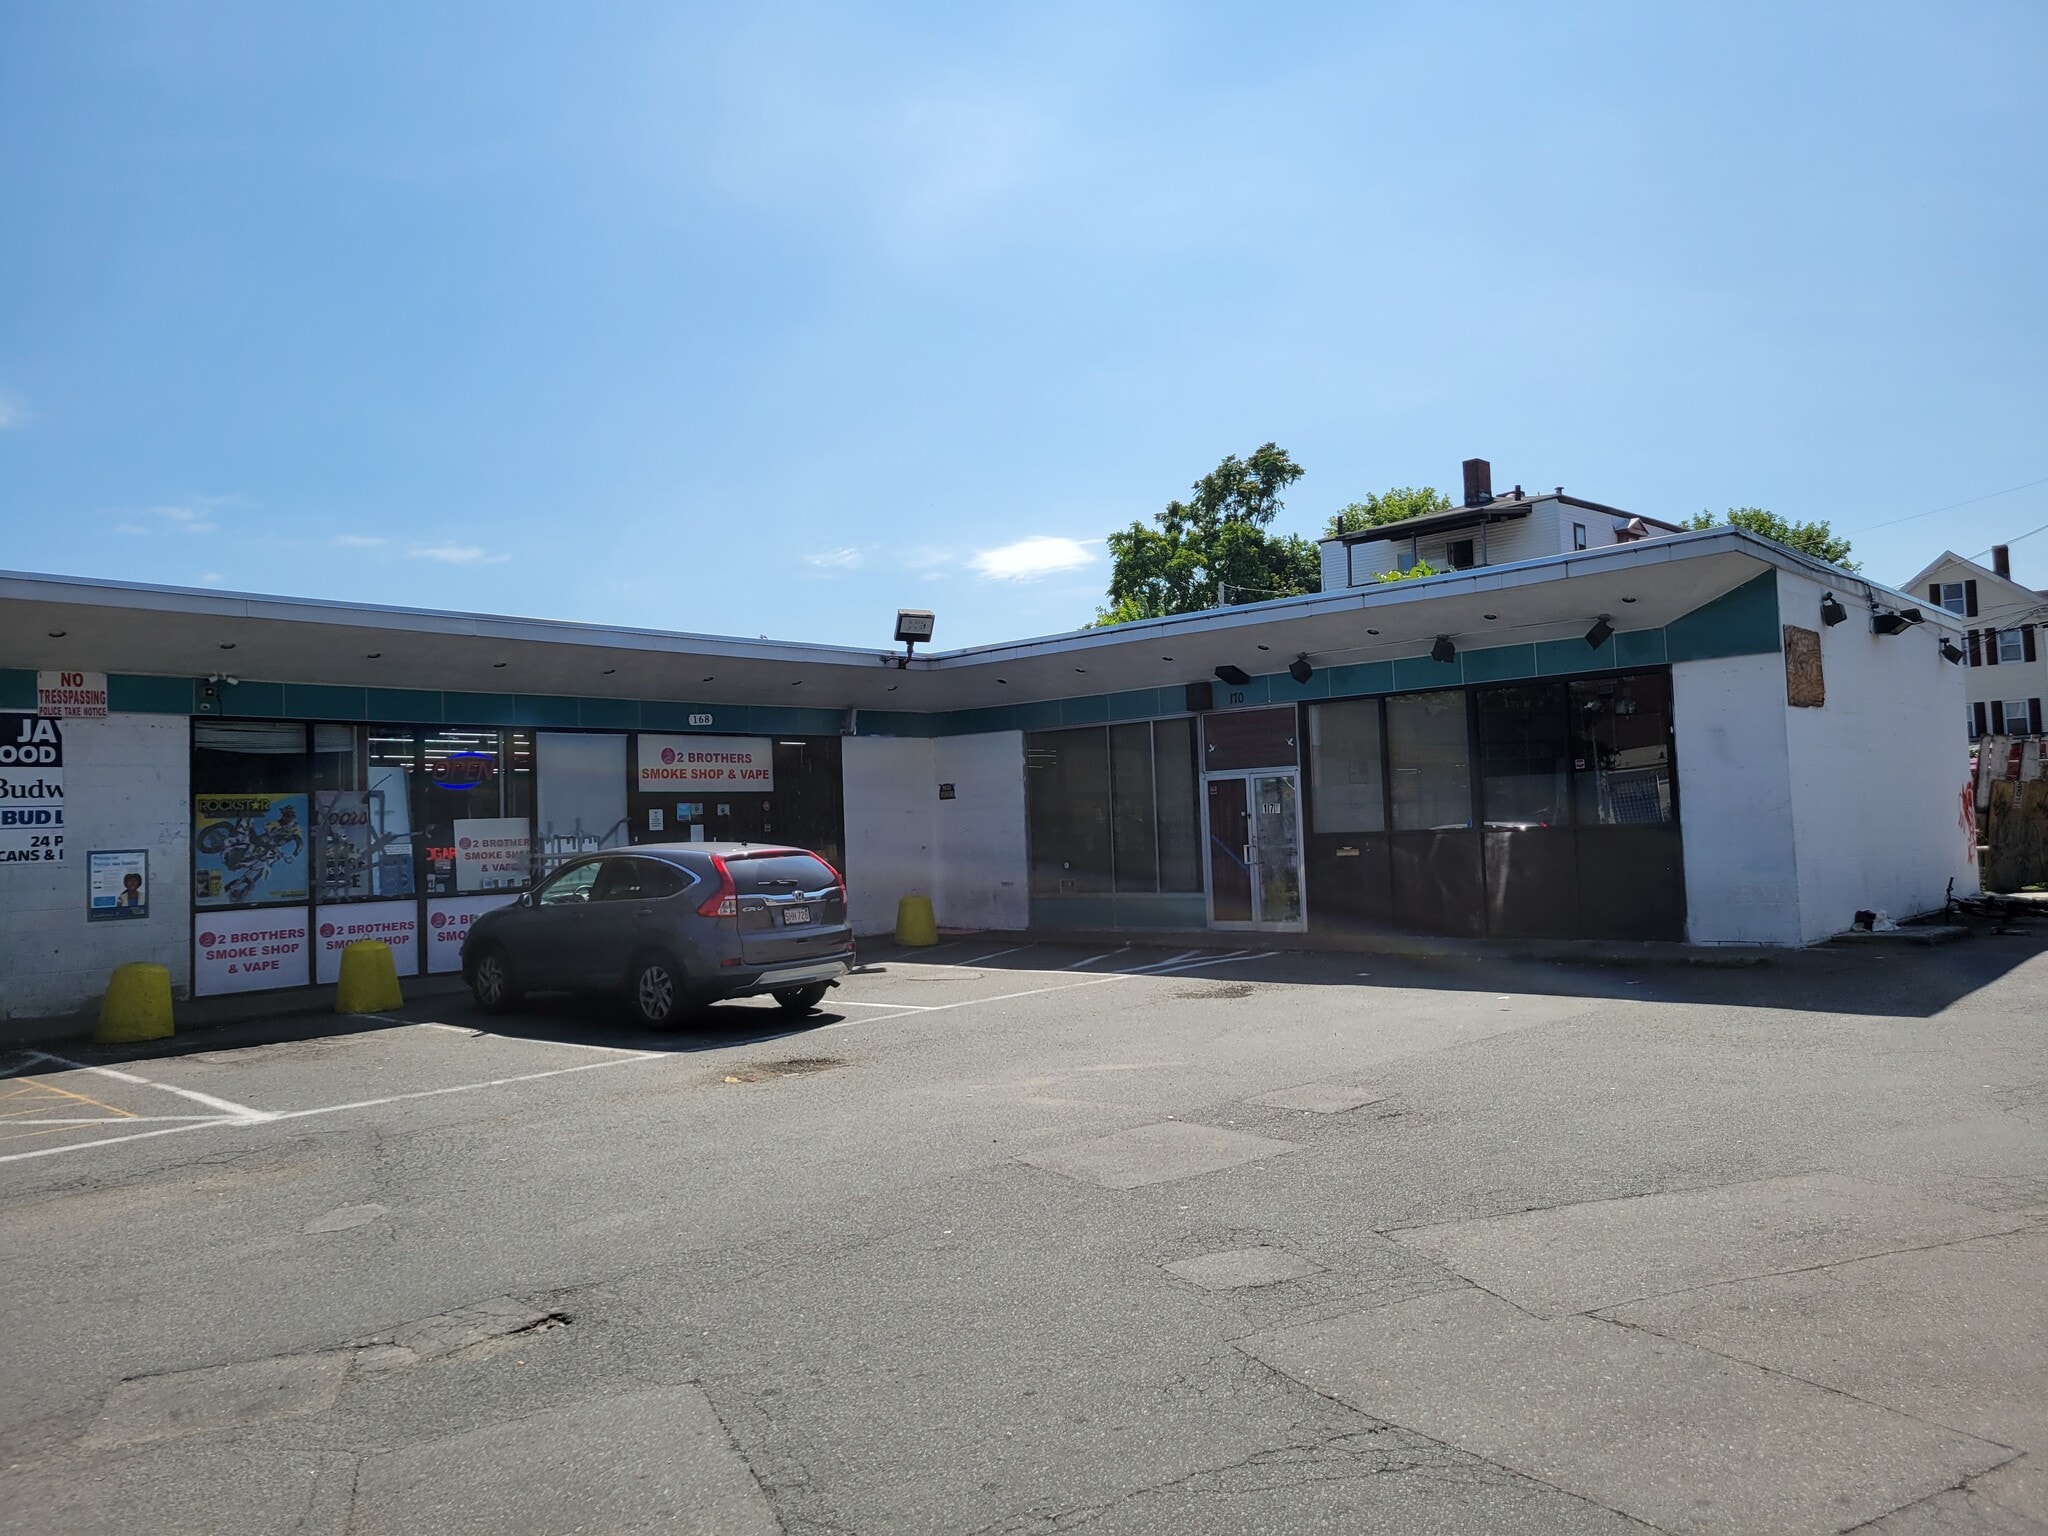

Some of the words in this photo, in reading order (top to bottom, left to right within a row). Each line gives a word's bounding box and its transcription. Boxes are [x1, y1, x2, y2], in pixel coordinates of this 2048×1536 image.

[61, 672, 84, 687] NO
[39, 689, 106, 705] TRESSPASSING
[1229, 692, 1244, 703] 170
[39, 706, 62, 715] POLICE
[64, 707, 81, 716] TAKE
[84, 707, 107, 716] NOTICE
[693, 715, 710, 724] 168
[677, 752, 684, 762] 2
[688, 752, 752, 764] BROTHERS
[433, 760, 494, 780] OPEN
[642, 768, 687, 779] SMOKE
[691, 768, 724, 779] SHOP
[728, 769, 736, 779] &
[740, 769, 769, 780] VAPE
[2, 810, 51, 825] BUD
[31, 836, 50, 847] 24
[473, 840, 480, 848] 2
[44, 849, 55, 860] &
[464, 851, 502, 860] SMOKE
[481, 864, 488, 872] &
[448, 915, 456, 925] 2
[336, 926, 344, 935] 2
[348, 921, 415, 934] BROTHERS
[218, 935, 226, 944] 2
[230, 929, 305, 943] BROTHERS
[206, 947, 257, 960] SMOKE
[261, 943, 299, 955] SHOP
[228, 964, 238, 974] &
[243, 960, 280, 972] VAPE
